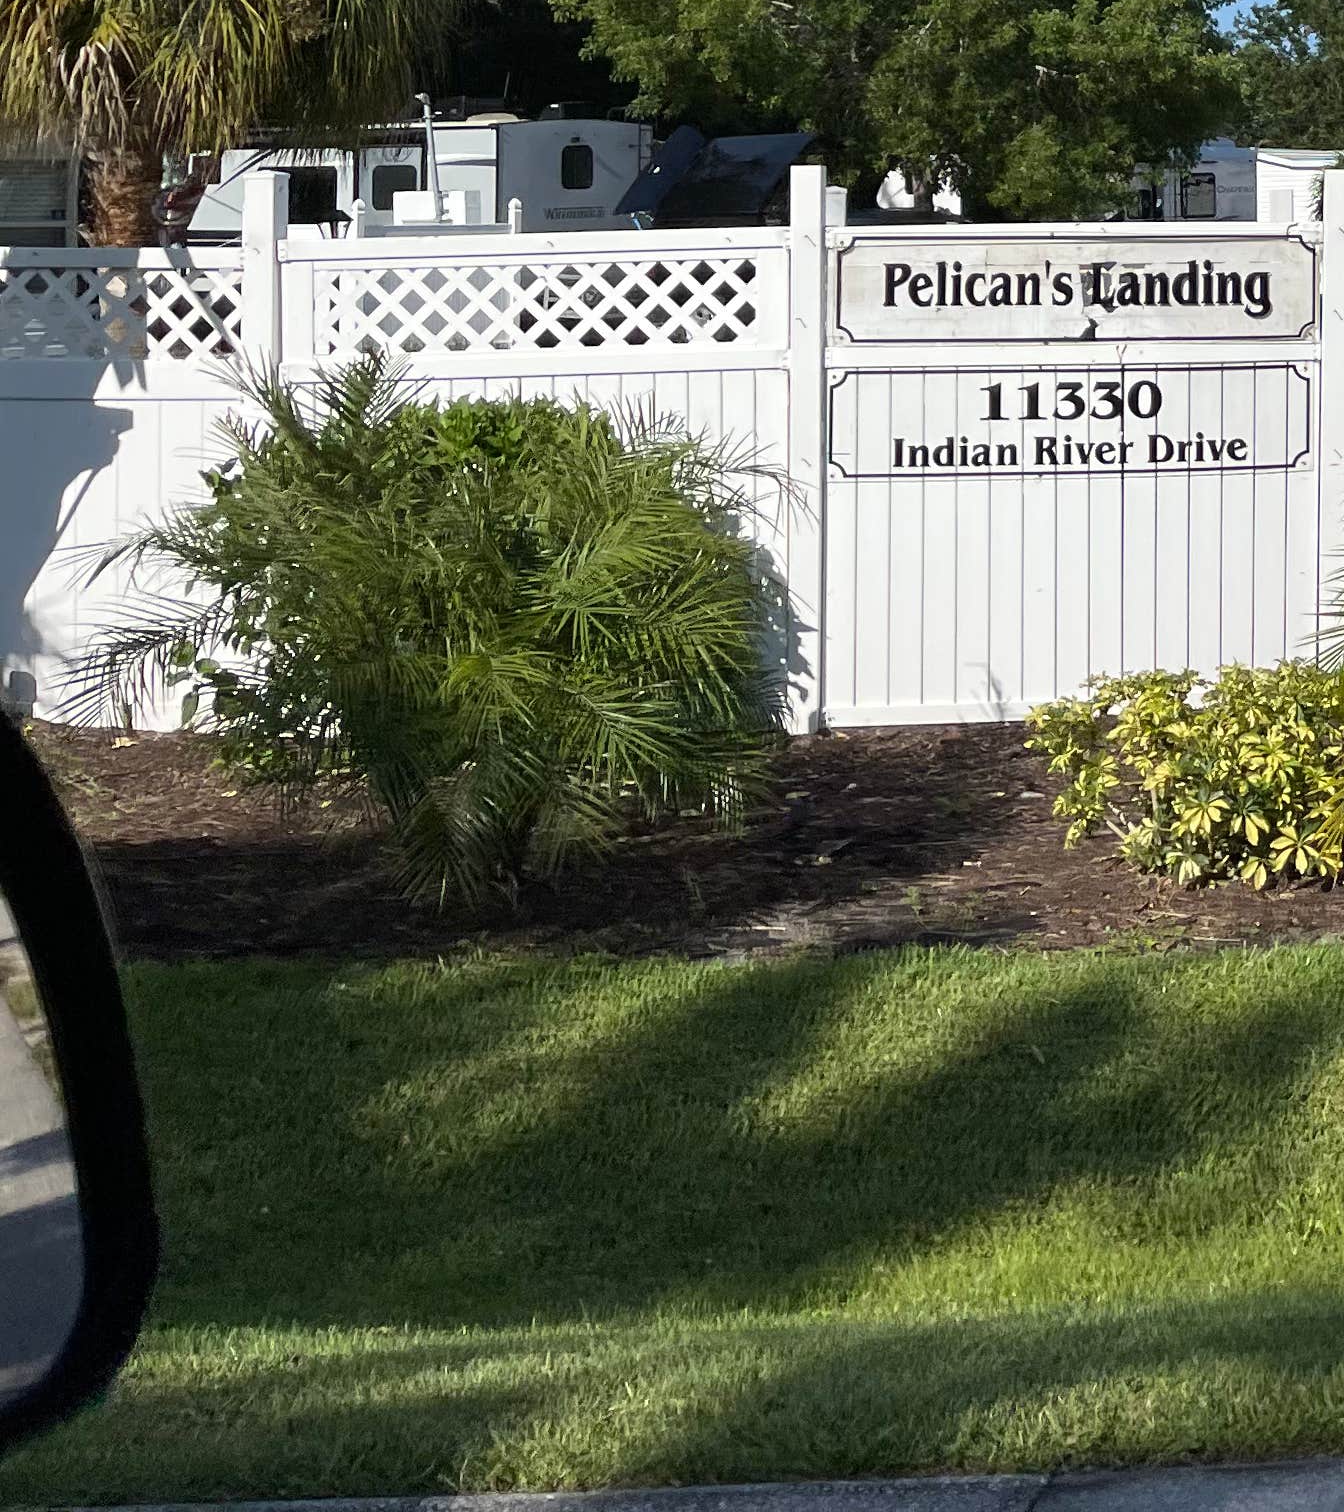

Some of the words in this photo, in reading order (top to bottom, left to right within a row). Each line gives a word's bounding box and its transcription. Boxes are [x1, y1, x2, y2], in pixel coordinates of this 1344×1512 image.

[883, 259, 1074, 307] Pelican's
[1090, 259, 1273, 319] Landing
[979, 380, 1162, 420] 11330
[893, 435, 1019, 468] Indian
[1034, 434, 1134, 465] River
[1147, 431, 1248, 463] Drive
